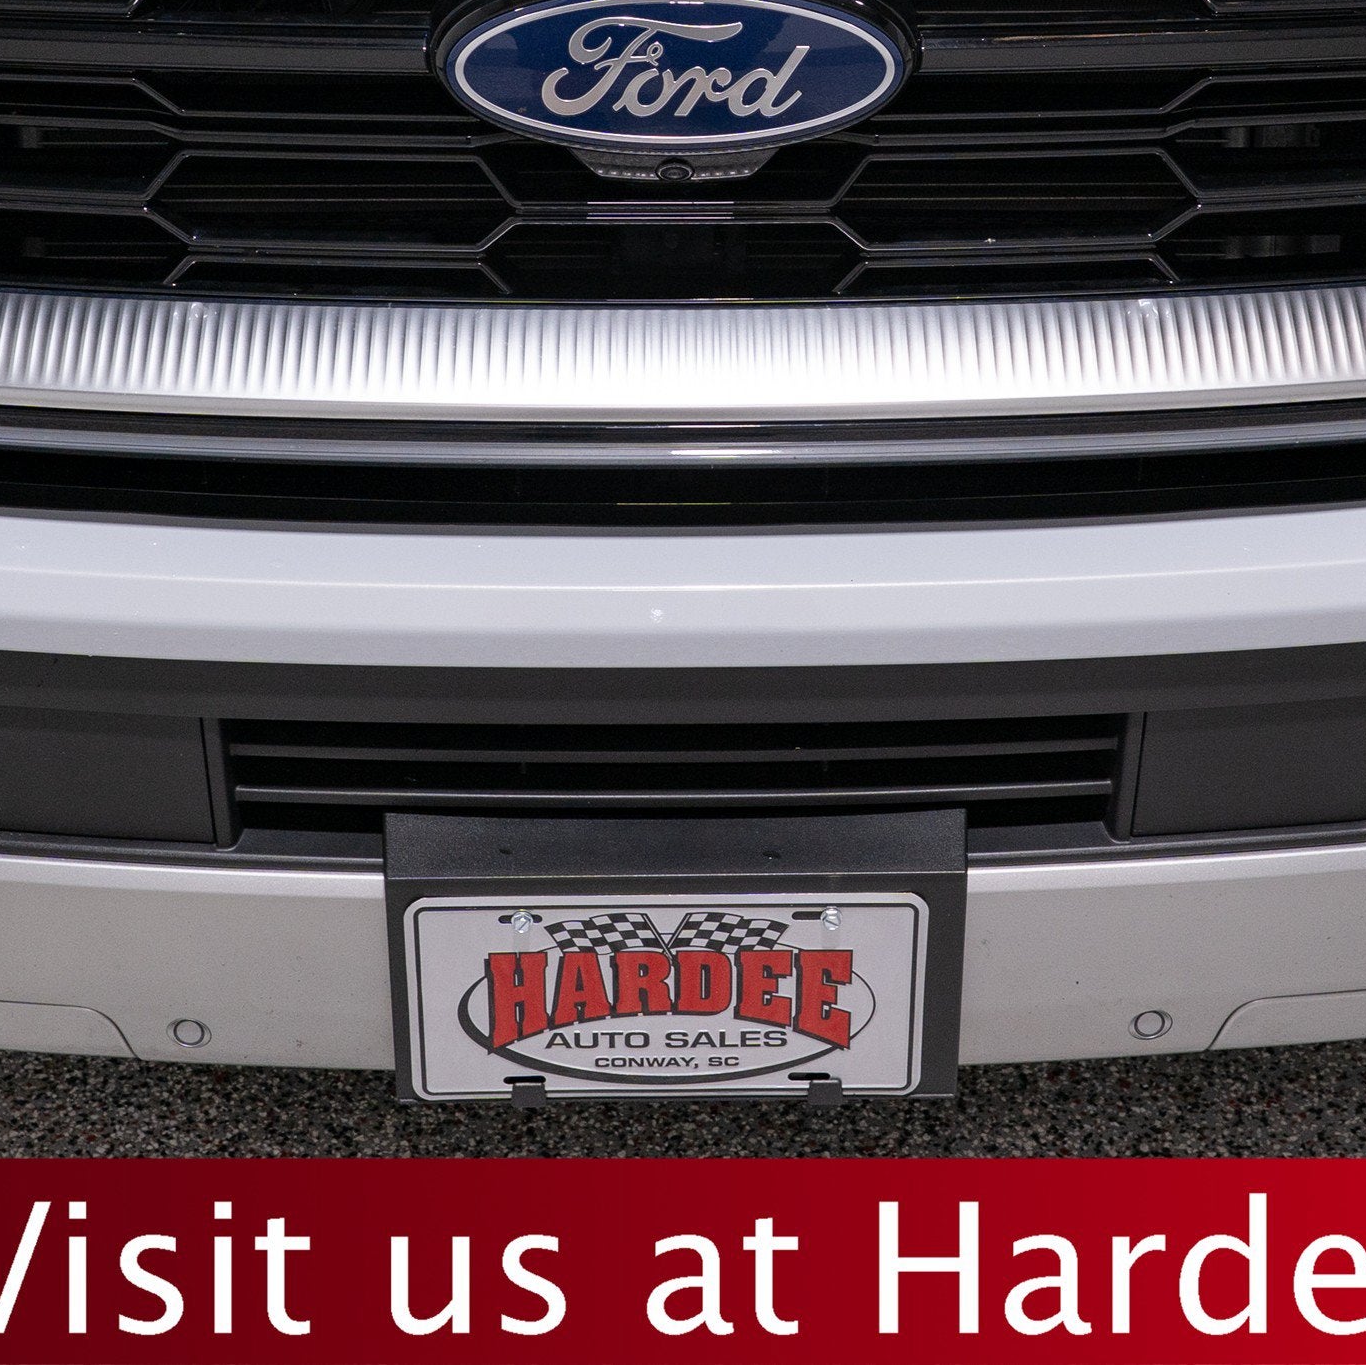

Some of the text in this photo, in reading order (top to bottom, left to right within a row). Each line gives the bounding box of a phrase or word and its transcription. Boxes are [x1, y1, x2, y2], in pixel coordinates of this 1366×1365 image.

[541, 16, 811, 117] Ford
[484, 949, 853, 1055] HARDEE
[545, 1029, 788, 1050] AUTO SALES
[593, 1055, 740, 1070] CONWAY, SC
